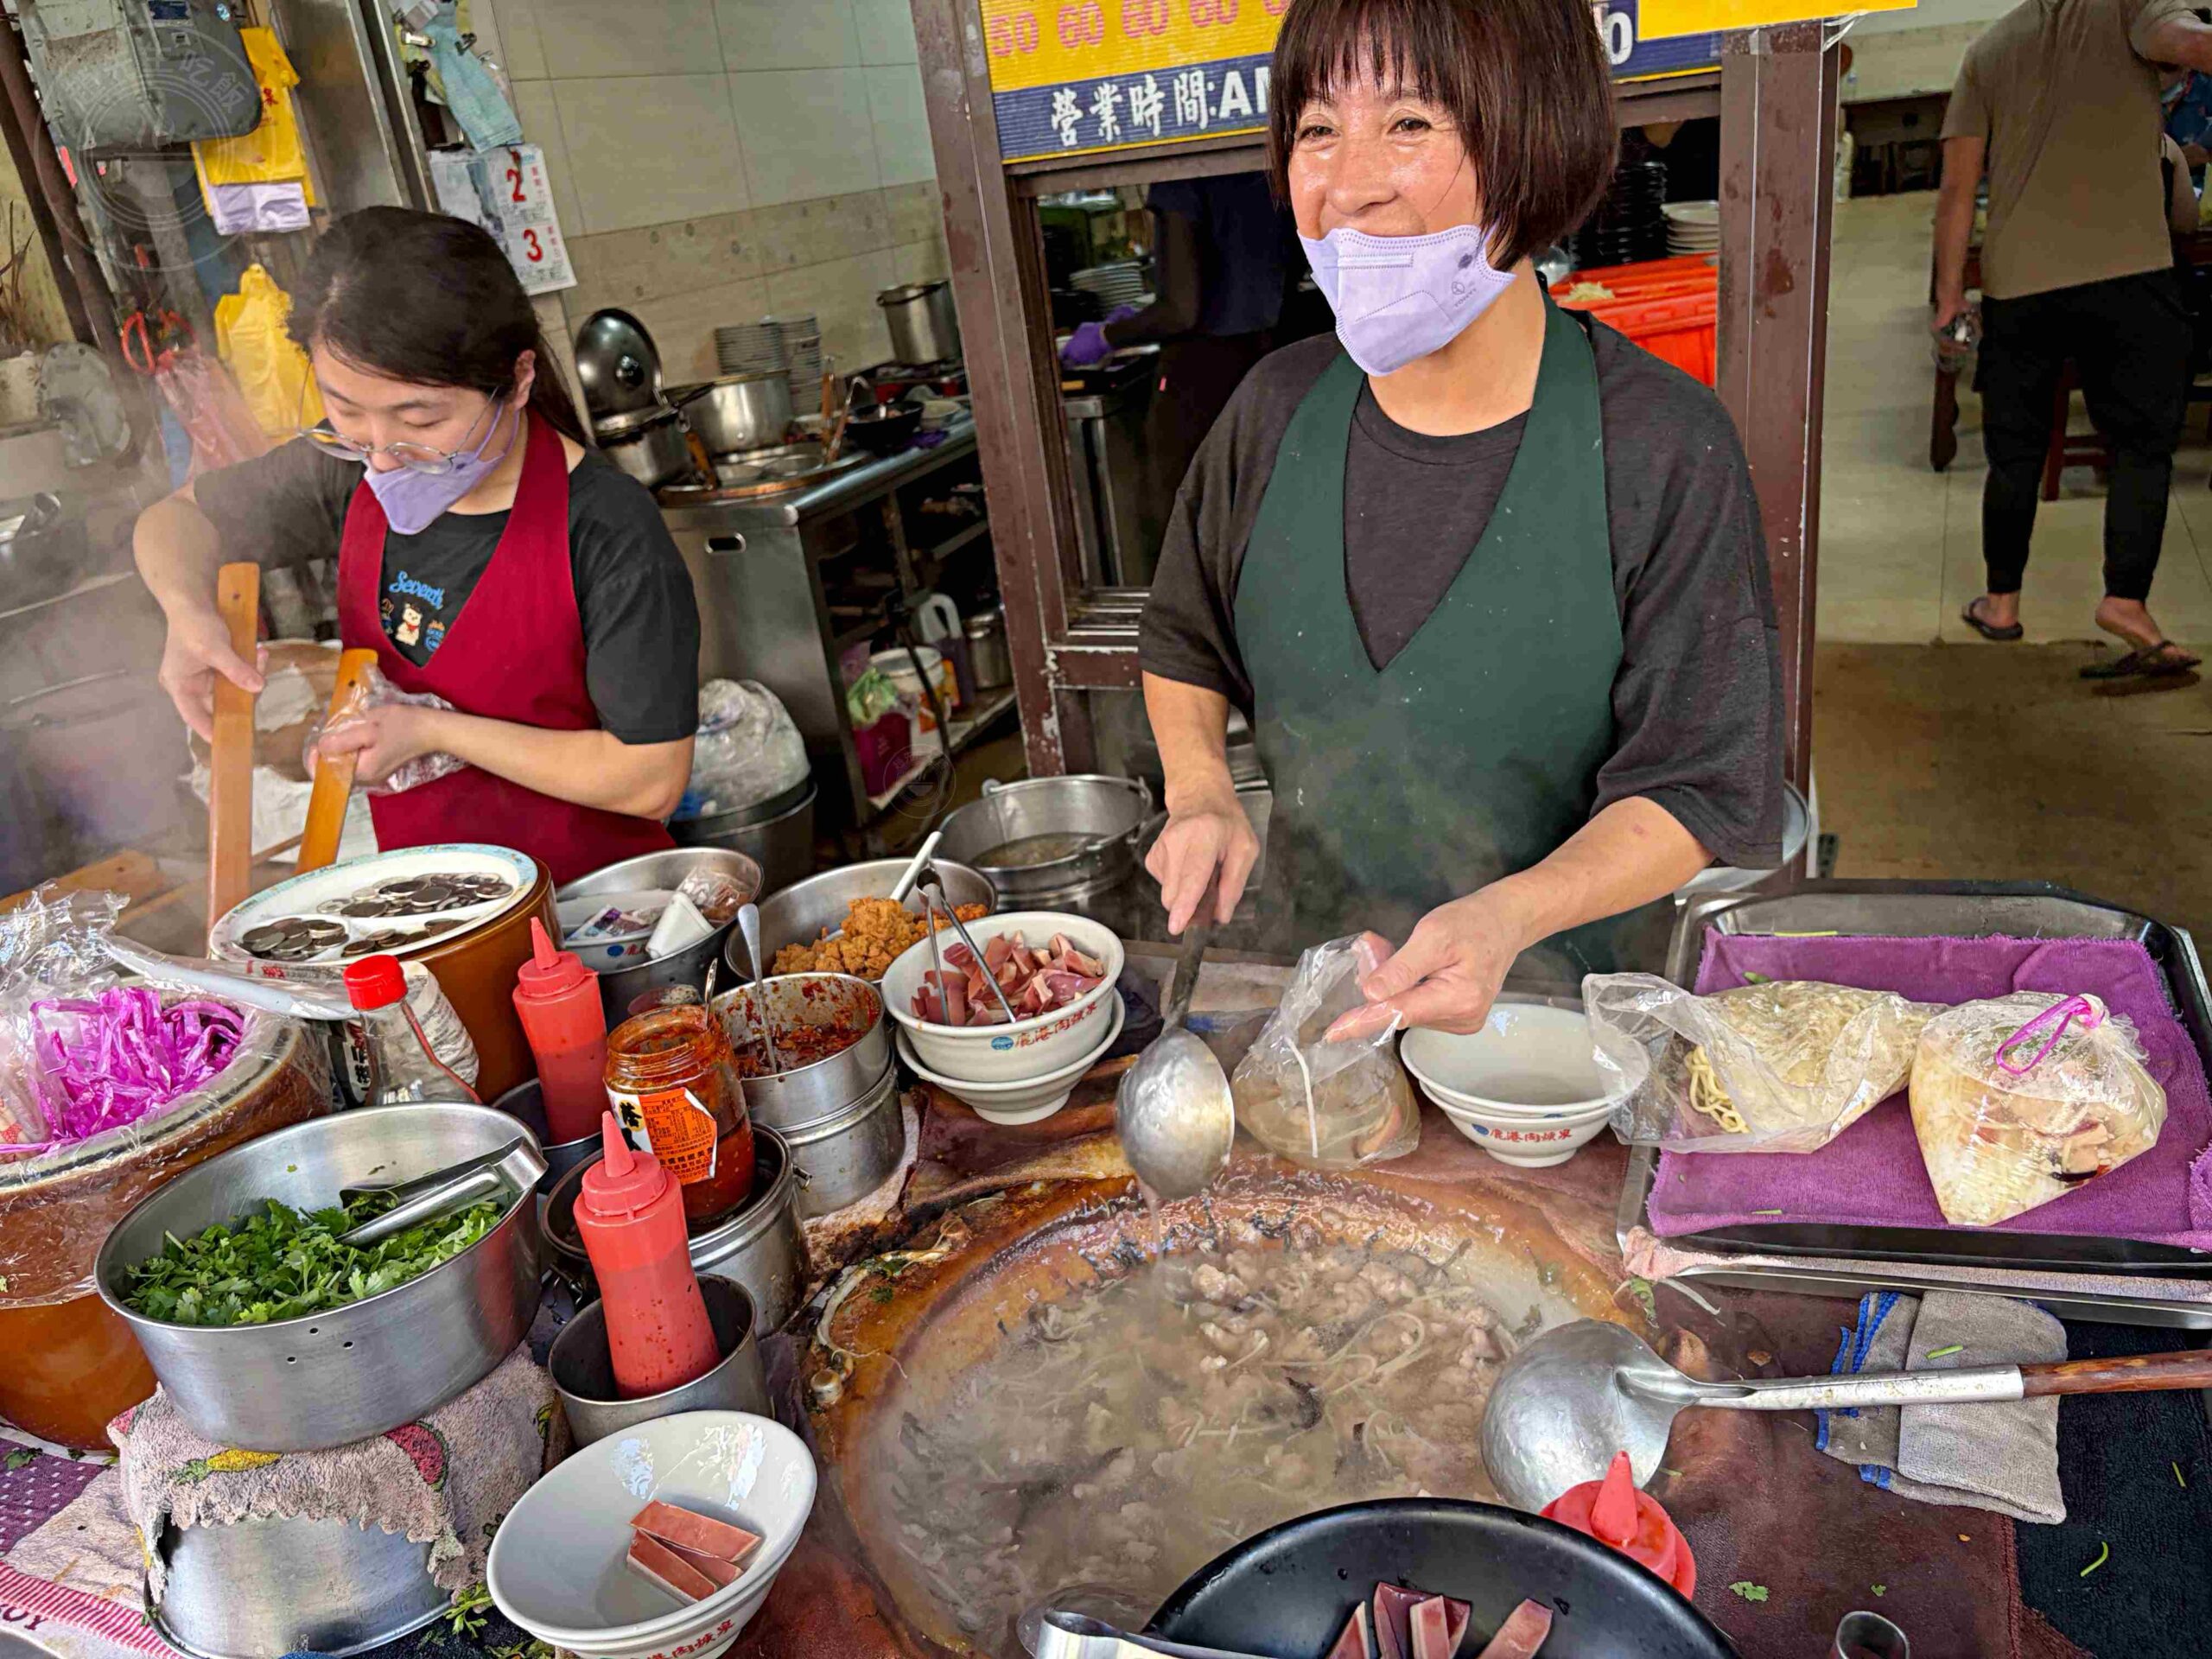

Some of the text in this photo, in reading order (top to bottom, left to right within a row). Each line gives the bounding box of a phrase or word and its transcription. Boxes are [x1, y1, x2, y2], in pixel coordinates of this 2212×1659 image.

[990, 12, 1039, 56] 50
[1058, 1, 1104, 48] 60
[1122, 0, 1167, 38] 60
[506, 168, 526, 202] 2
[523, 229, 543, 262] 3
